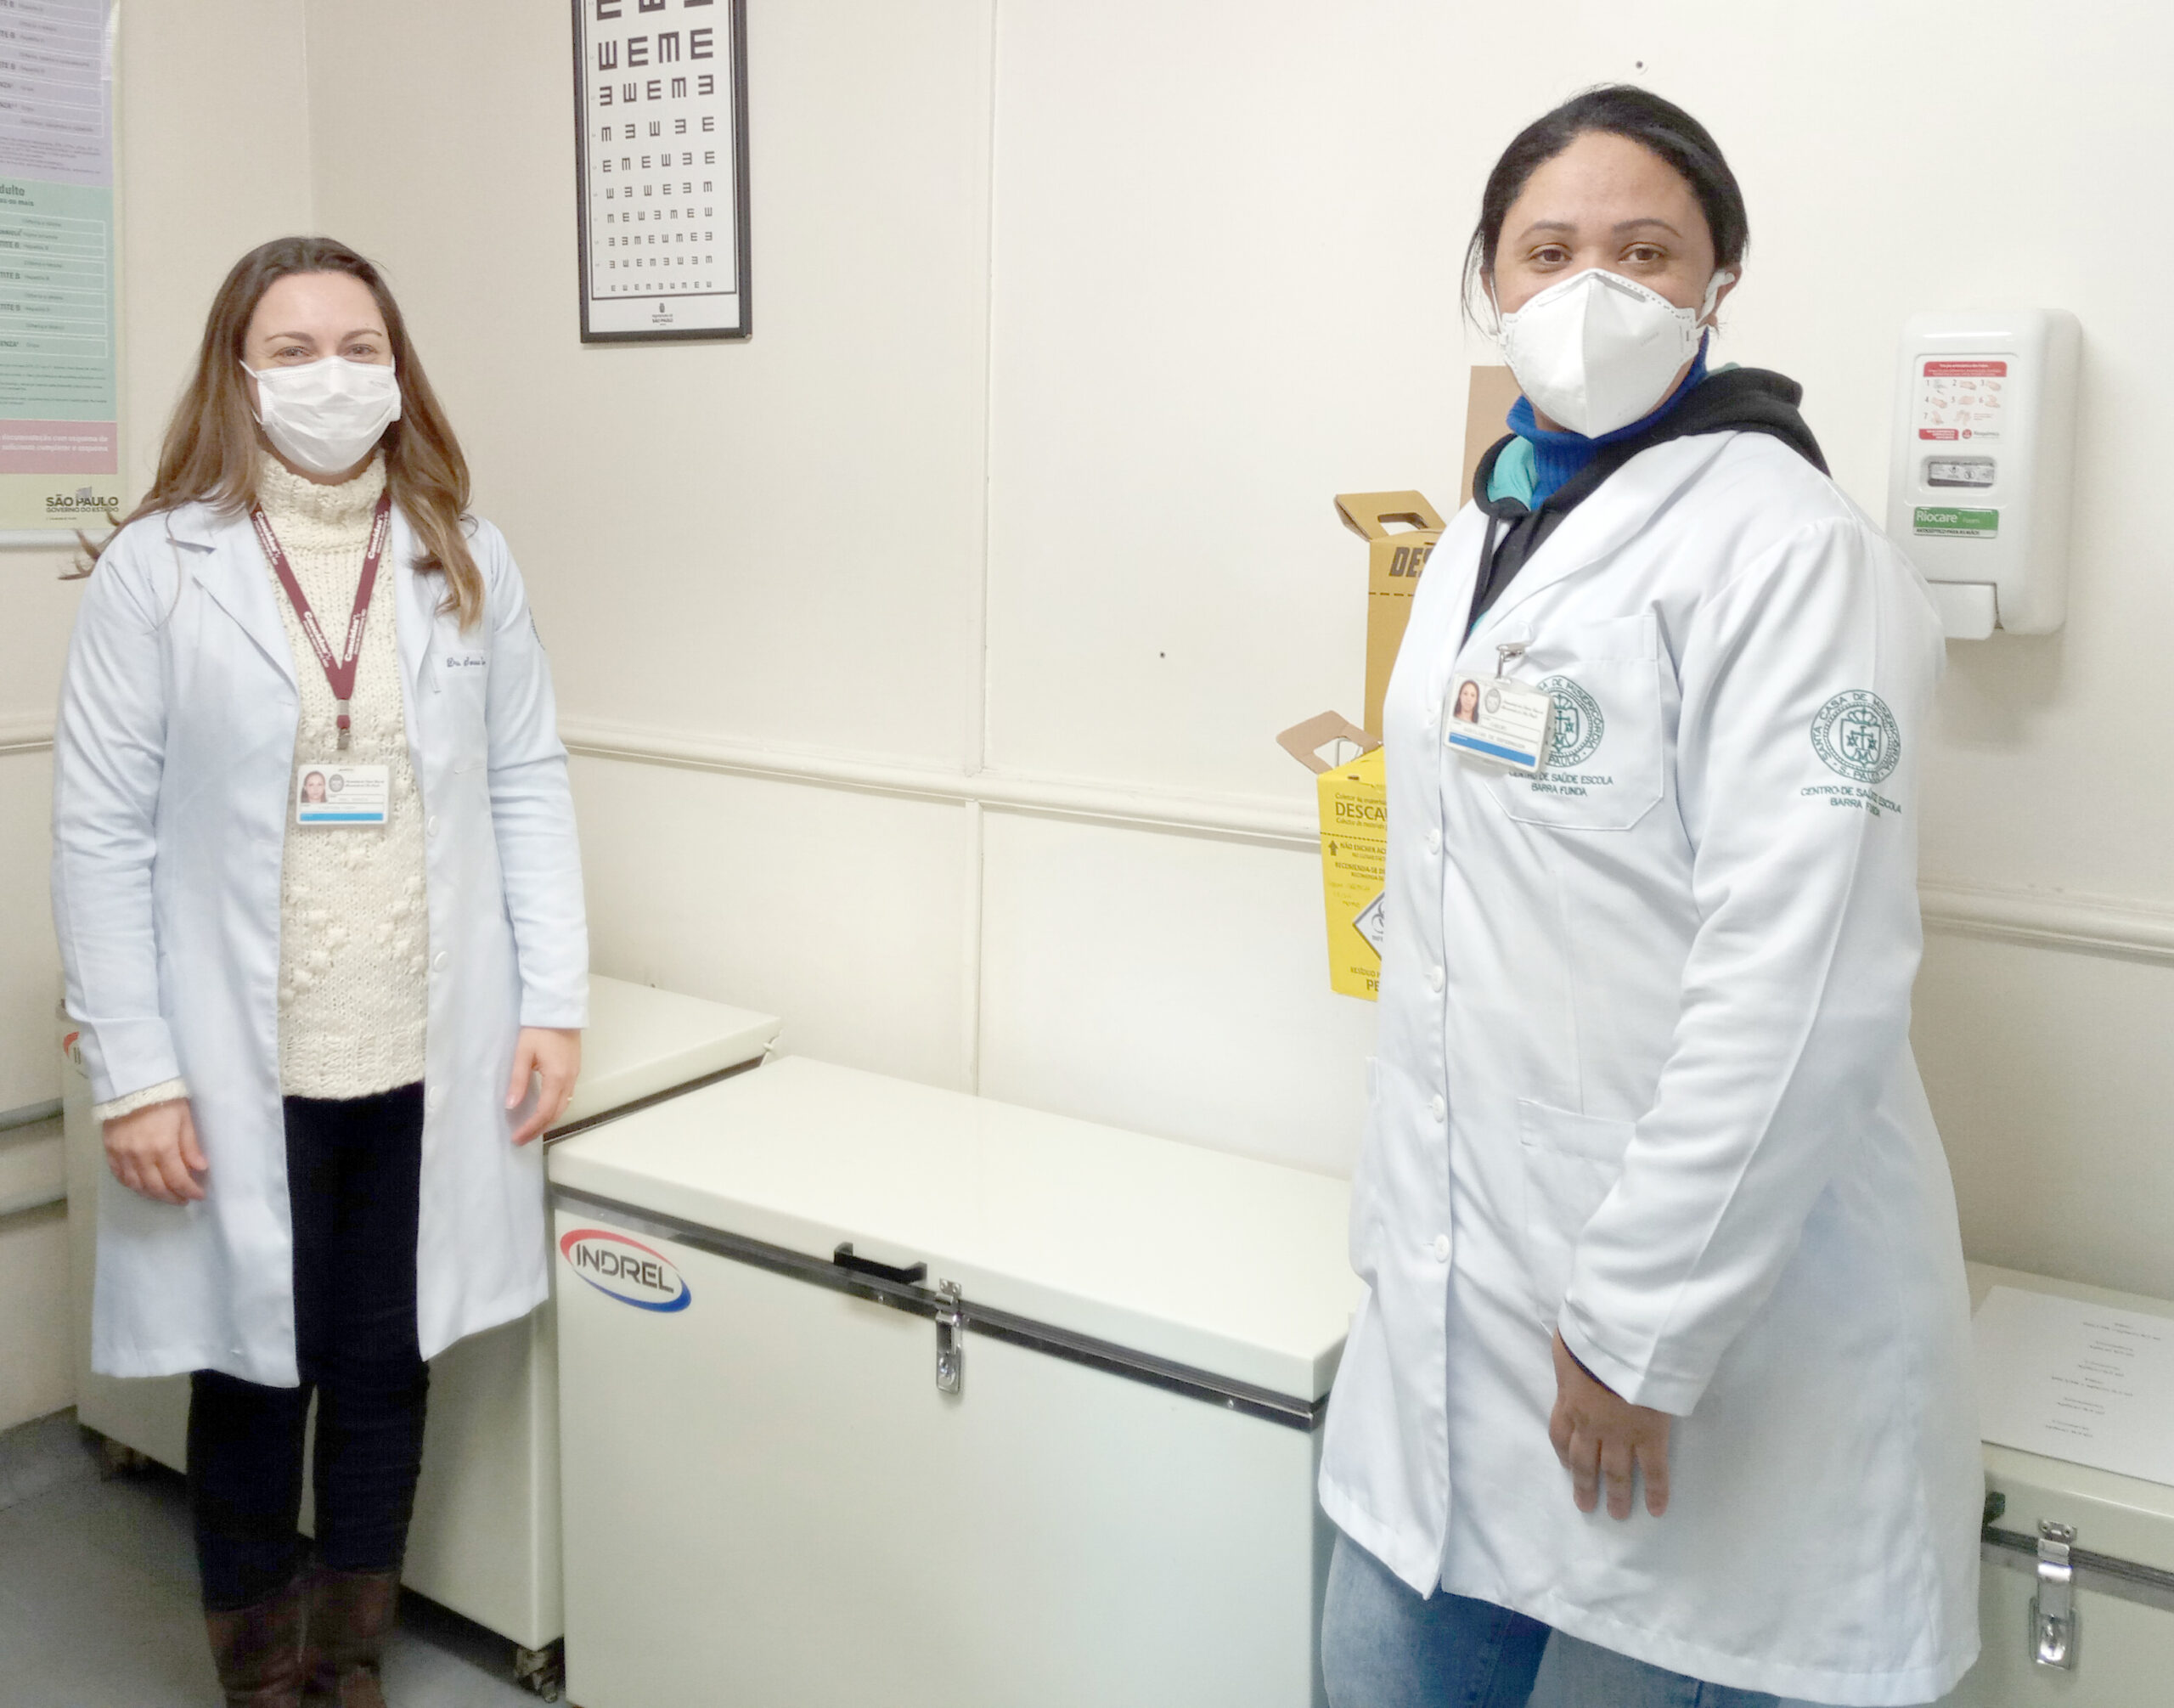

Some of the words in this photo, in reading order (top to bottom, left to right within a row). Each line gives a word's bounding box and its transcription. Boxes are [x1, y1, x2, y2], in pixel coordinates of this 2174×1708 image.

[46, 493, 74, 507] SÃO
[76, 496, 119, 507] PAULO
[1916, 510, 1958, 523] Riocare
[1853, 692, 1867, 702] DE
[1819, 696, 1848, 720] CASA
[1813, 726, 1832, 761] SANTA
[1548, 753, 1580, 765] PAULO
[1551, 771, 1578, 784] SAÚDE
[1580, 775, 1614, 785] ESCOLA
[1531, 782, 1558, 794] BARRA
[1559, 786, 1588, 797] FUNDA
[1800, 786, 1839, 797] CENTRO
[1840, 786, 1854, 796] DE
[1830, 797, 1863, 809] BARRA
[1334, 801, 1387, 822] DESCA
[576, 1243, 674, 1294] INDREL
